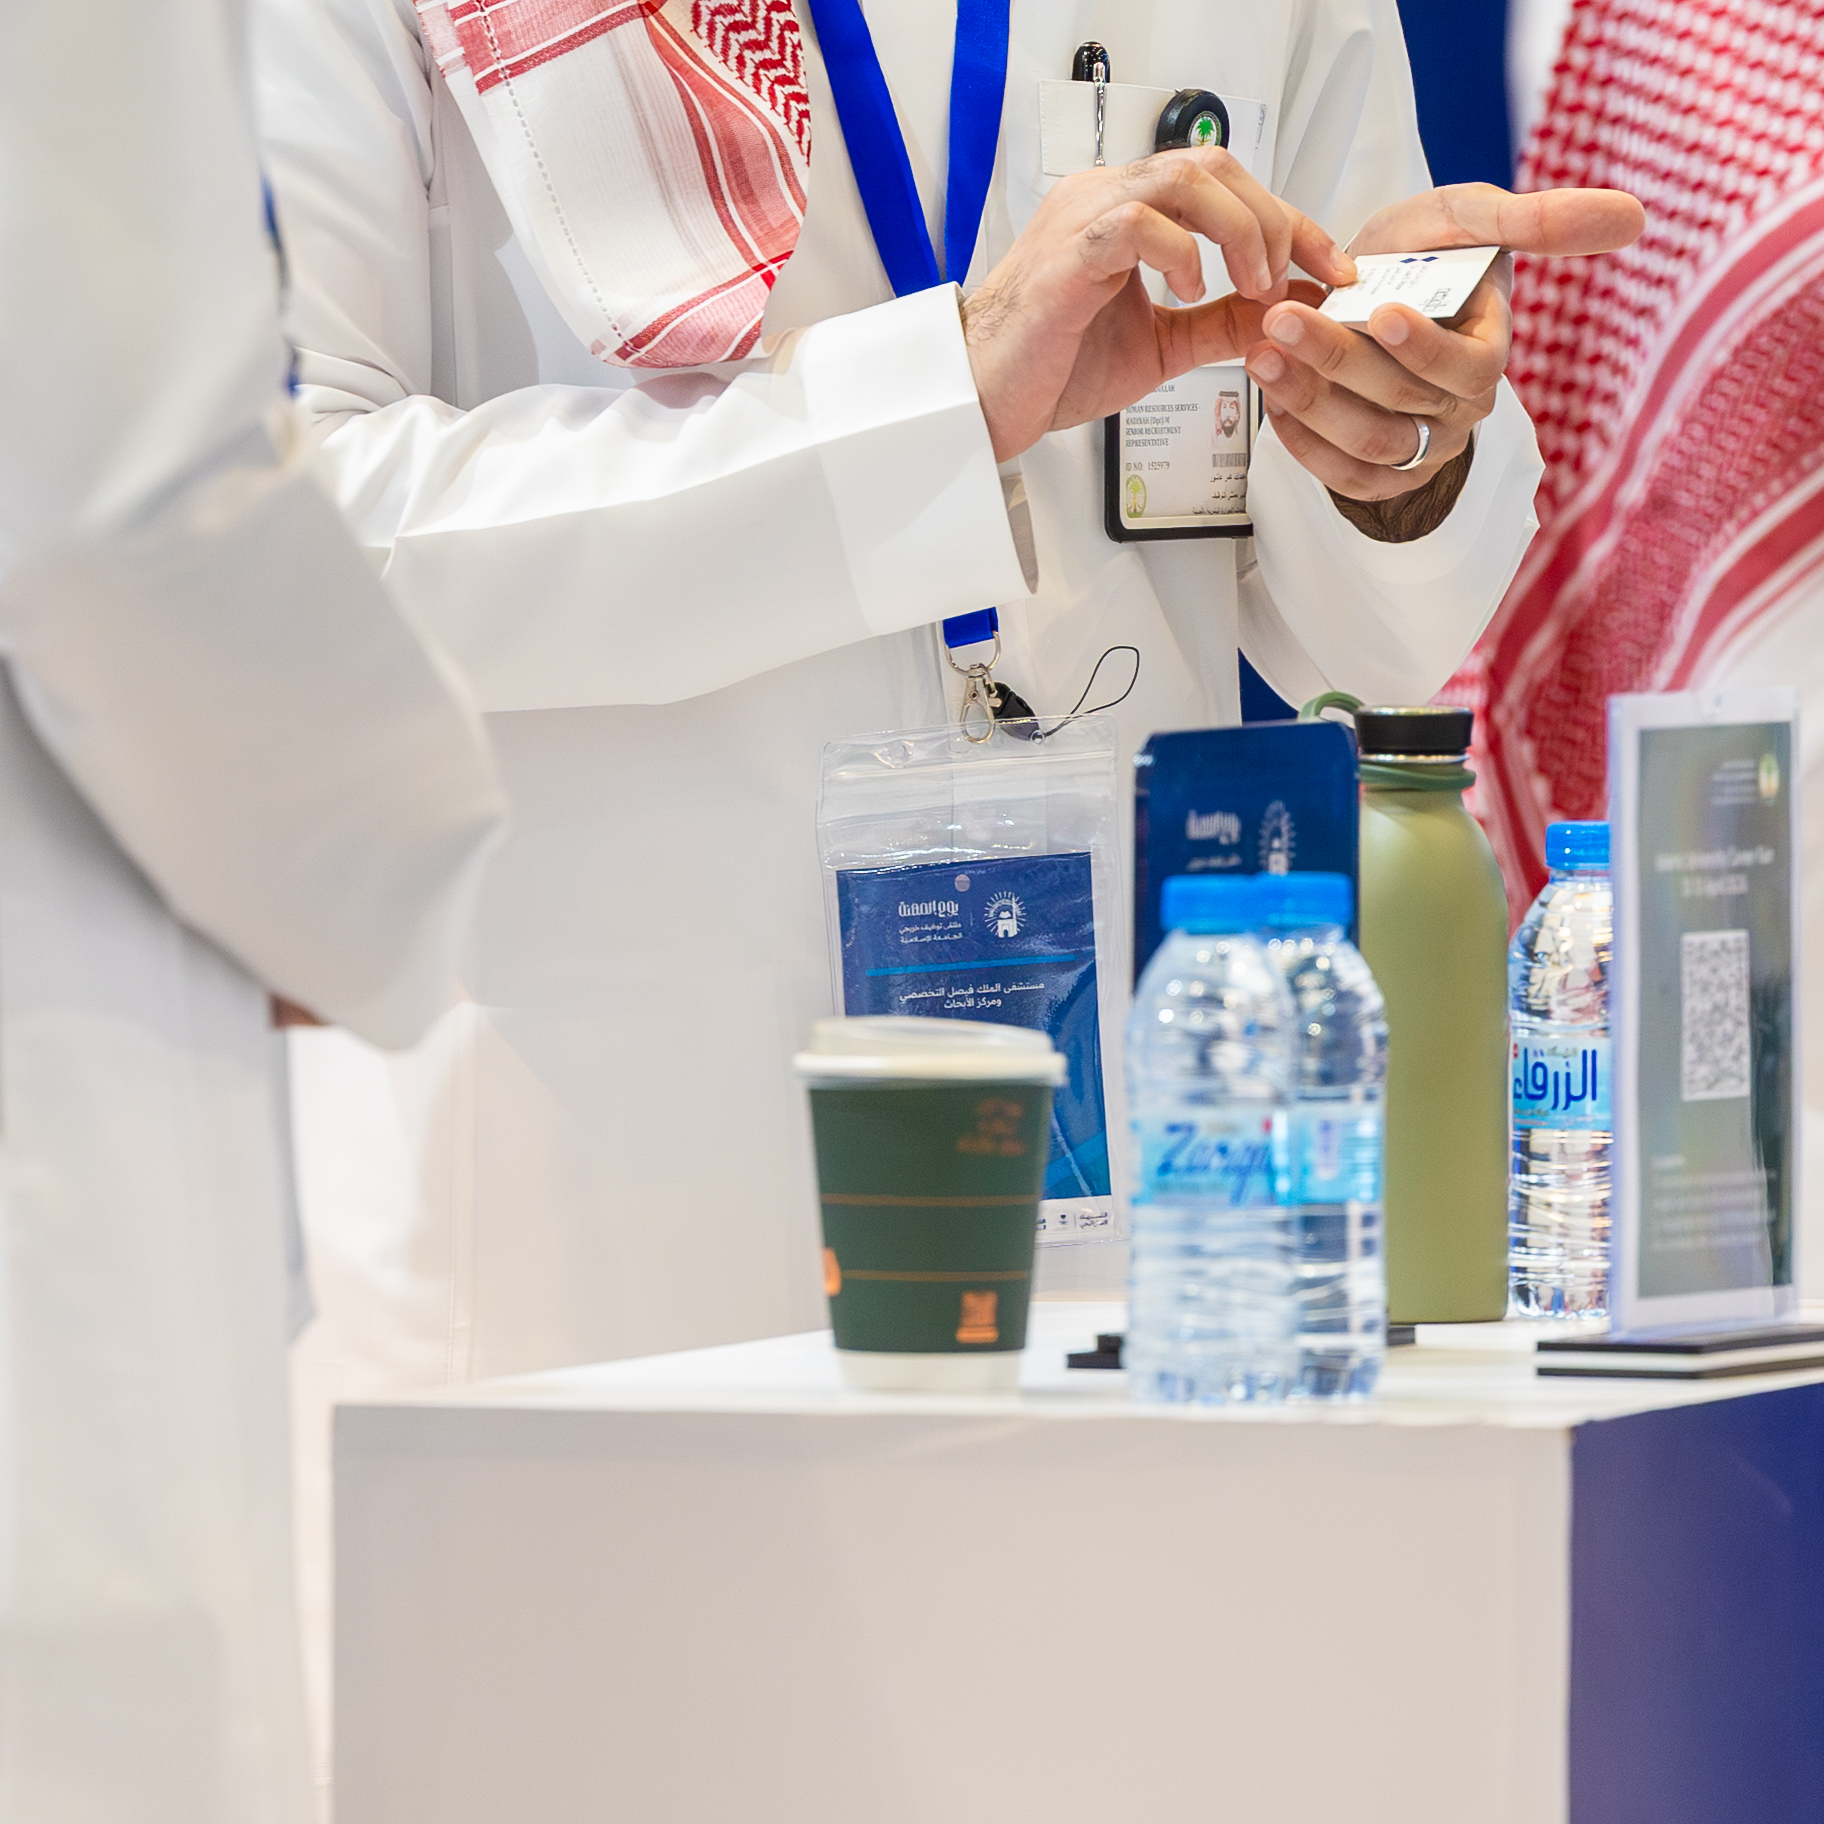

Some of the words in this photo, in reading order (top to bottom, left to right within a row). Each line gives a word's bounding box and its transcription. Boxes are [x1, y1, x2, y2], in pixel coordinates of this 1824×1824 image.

[1144, 404, 1174, 413] RESOURCES
[1174, 403, 1199, 412] SERVICES
[1125, 427, 1144, 436] SENIOR
[1144, 426, 1181, 435] RECRUITMENT
[1125, 438, 1169, 447] REPRESENTATIVE
[1125, 462, 1132, 471] ID
[932, 932, 963, 941] الجامعة
[946, 983, 975, 997] فيصل
[976, 983, 1001, 994] الملك
[1003, 981, 1045, 994] مستشفى
[898, 987, 945, 1006] التخصصي
[976, 996, 1002, 1008] ومركز
[943, 997, 975, 1009] الأبحاث
